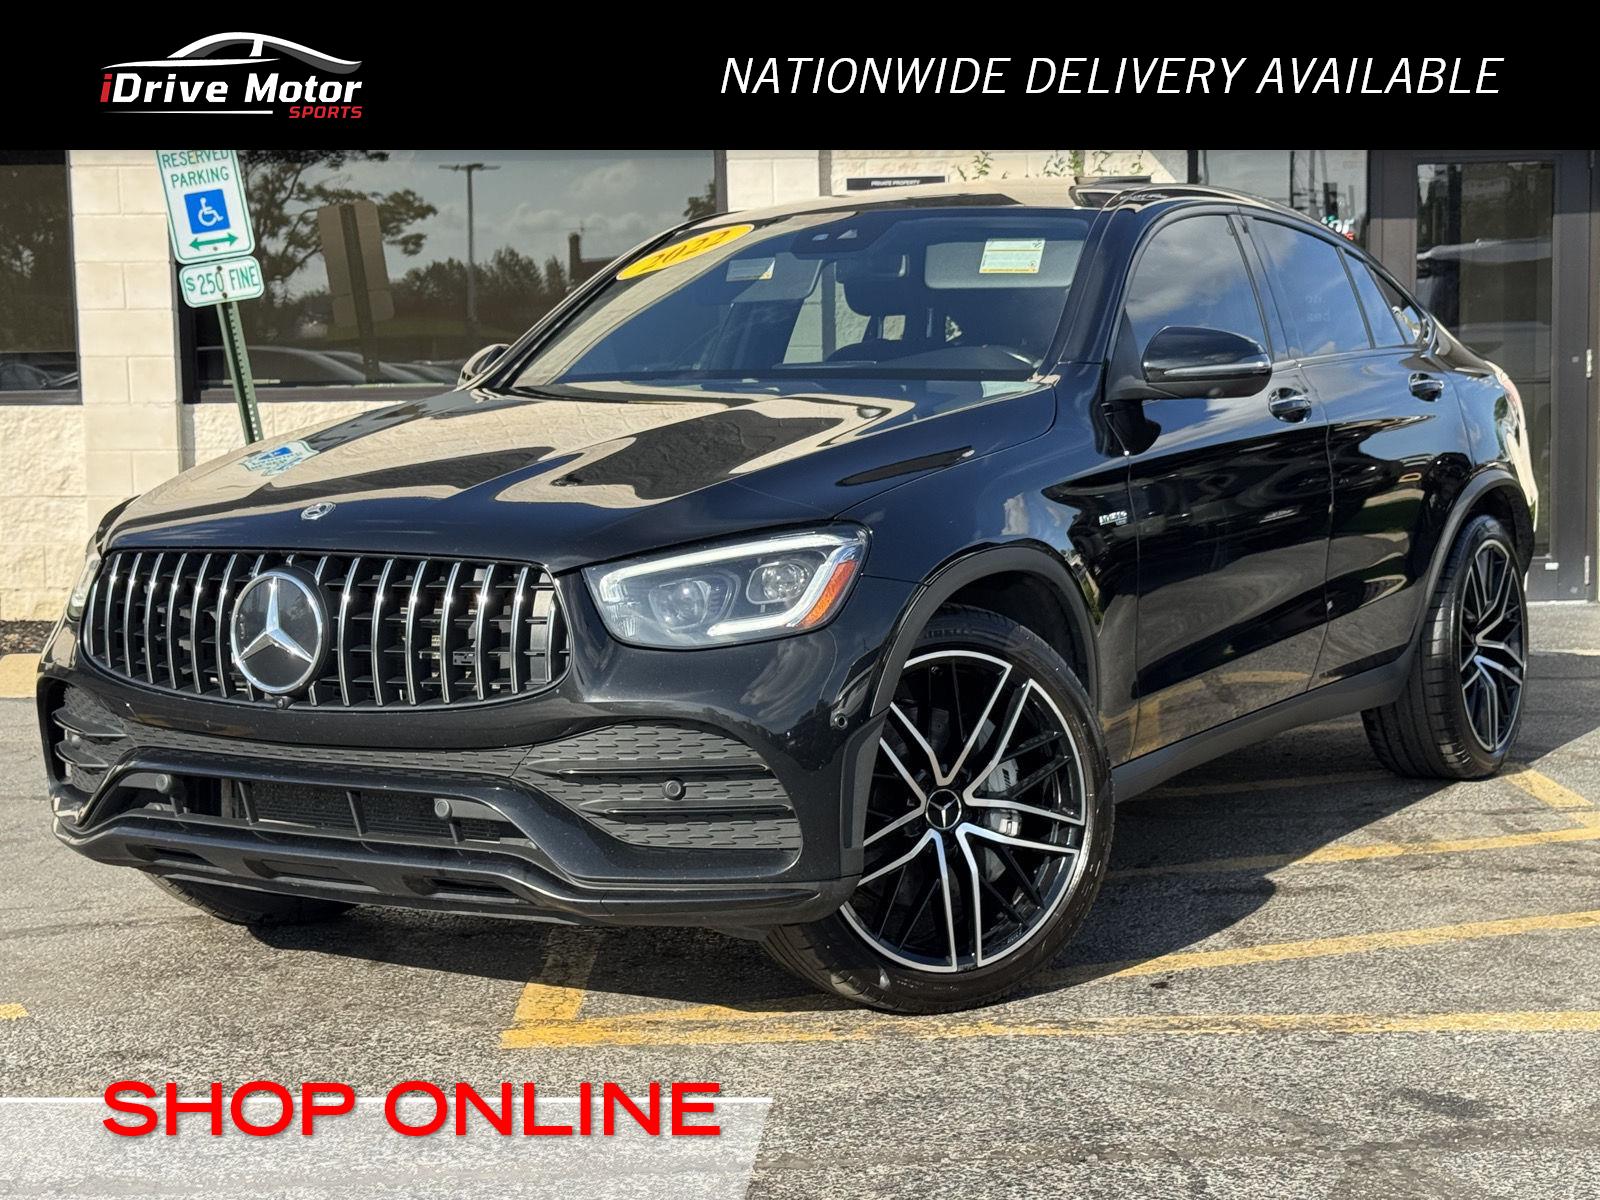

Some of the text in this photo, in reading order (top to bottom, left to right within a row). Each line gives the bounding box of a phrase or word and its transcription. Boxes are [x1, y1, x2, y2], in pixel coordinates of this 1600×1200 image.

[161, 150, 229, 169] RESERVED
[170, 166, 230, 188] PARKING
[638, 230, 730, 272] 2022
[229, 266, 260, 291] FINE
